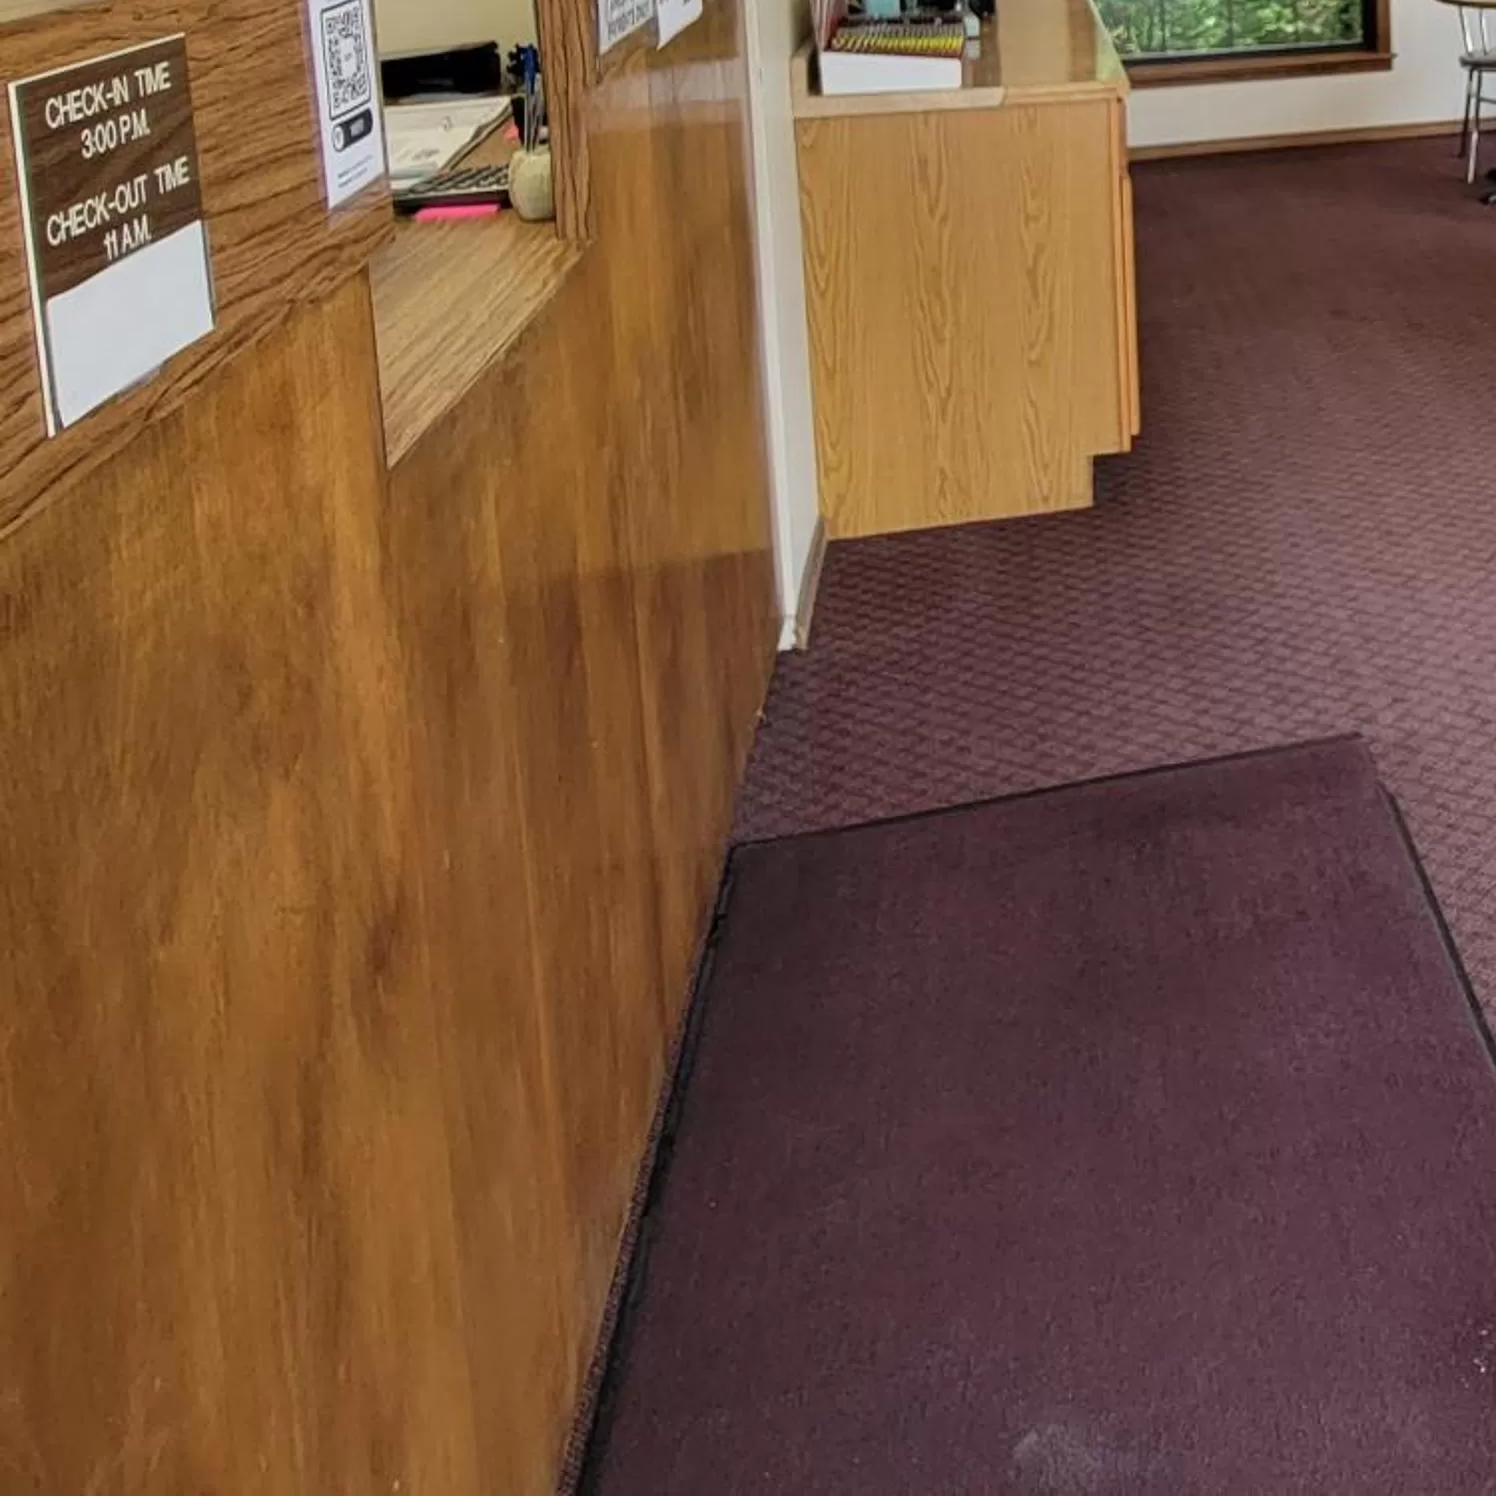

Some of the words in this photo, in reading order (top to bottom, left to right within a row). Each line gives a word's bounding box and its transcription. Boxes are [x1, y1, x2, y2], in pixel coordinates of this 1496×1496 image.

[45, 76, 130, 129] CHECK-IN
[134, 61, 171, 97] TIME
[47, 173, 148, 246] CHECK-OUT
[154, 155, 191, 195] TIME
[103, 228, 118, 260] 11
